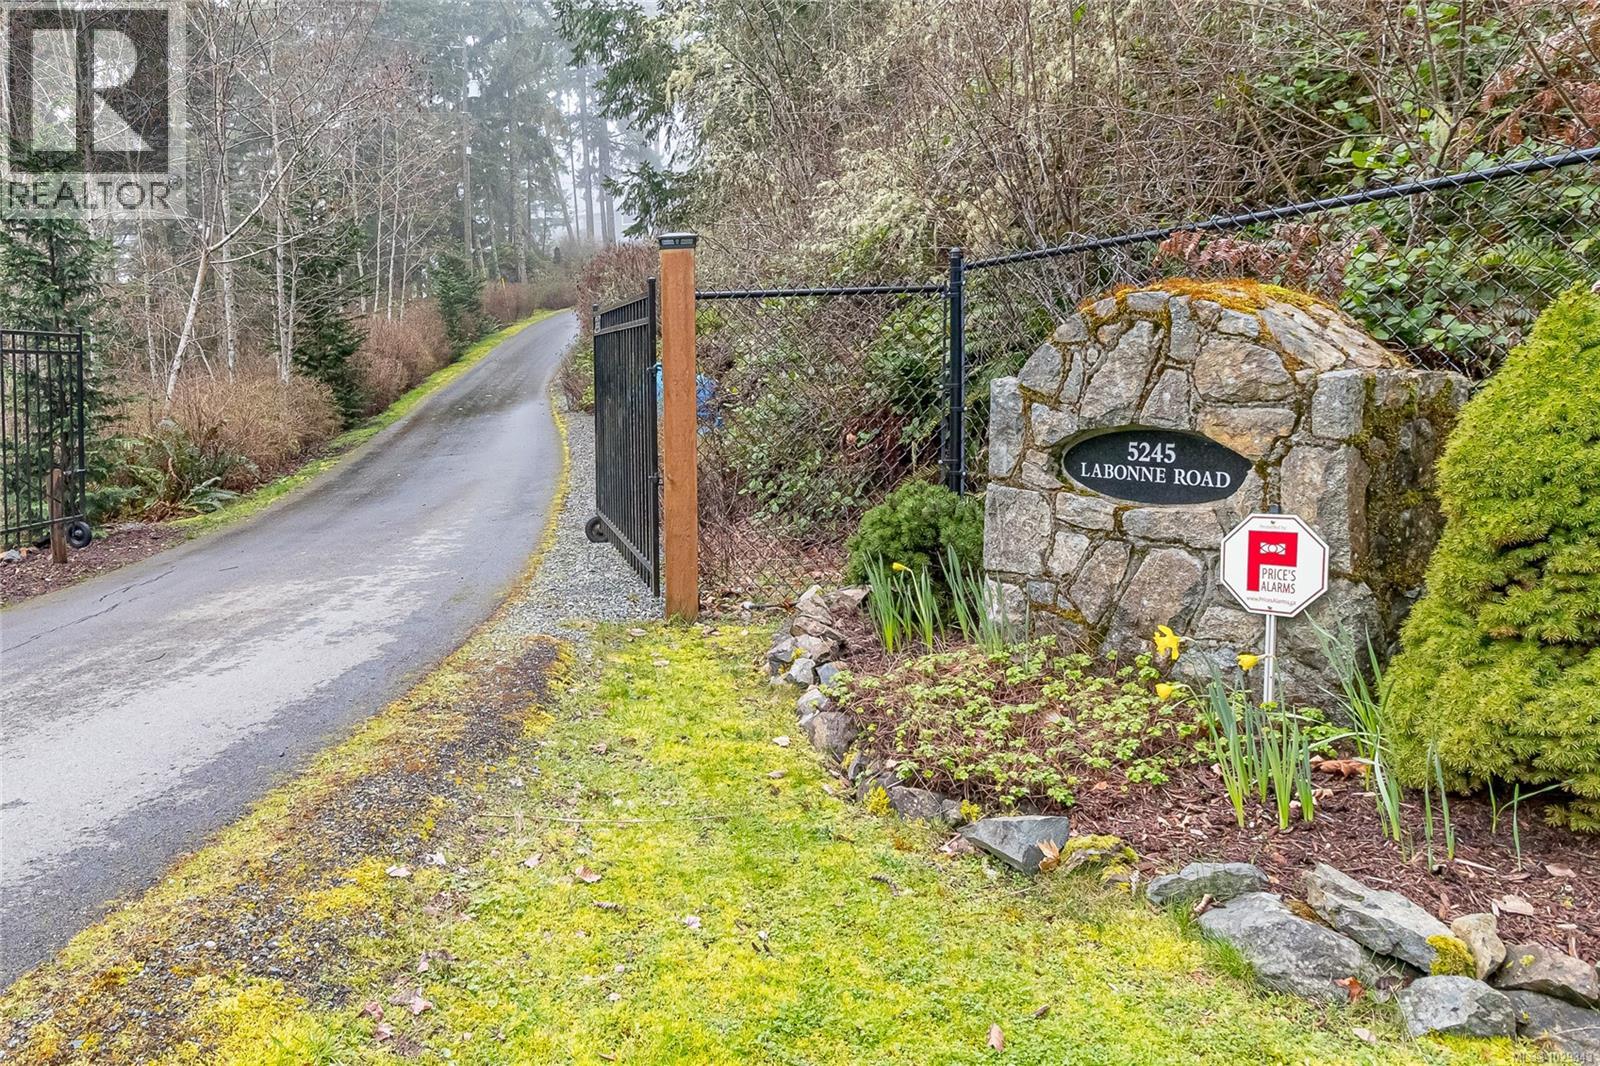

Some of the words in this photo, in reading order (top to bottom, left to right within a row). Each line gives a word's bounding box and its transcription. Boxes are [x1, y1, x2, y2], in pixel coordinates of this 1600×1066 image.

[1127, 441, 1176, 464] 5245
[1080, 462, 1166, 483] LABONNE
[1173, 468, 1231, 488] ROAD
[1261, 567, 1297, 582] PRICE'S
[1261, 581, 1296, 595] ALARMS
